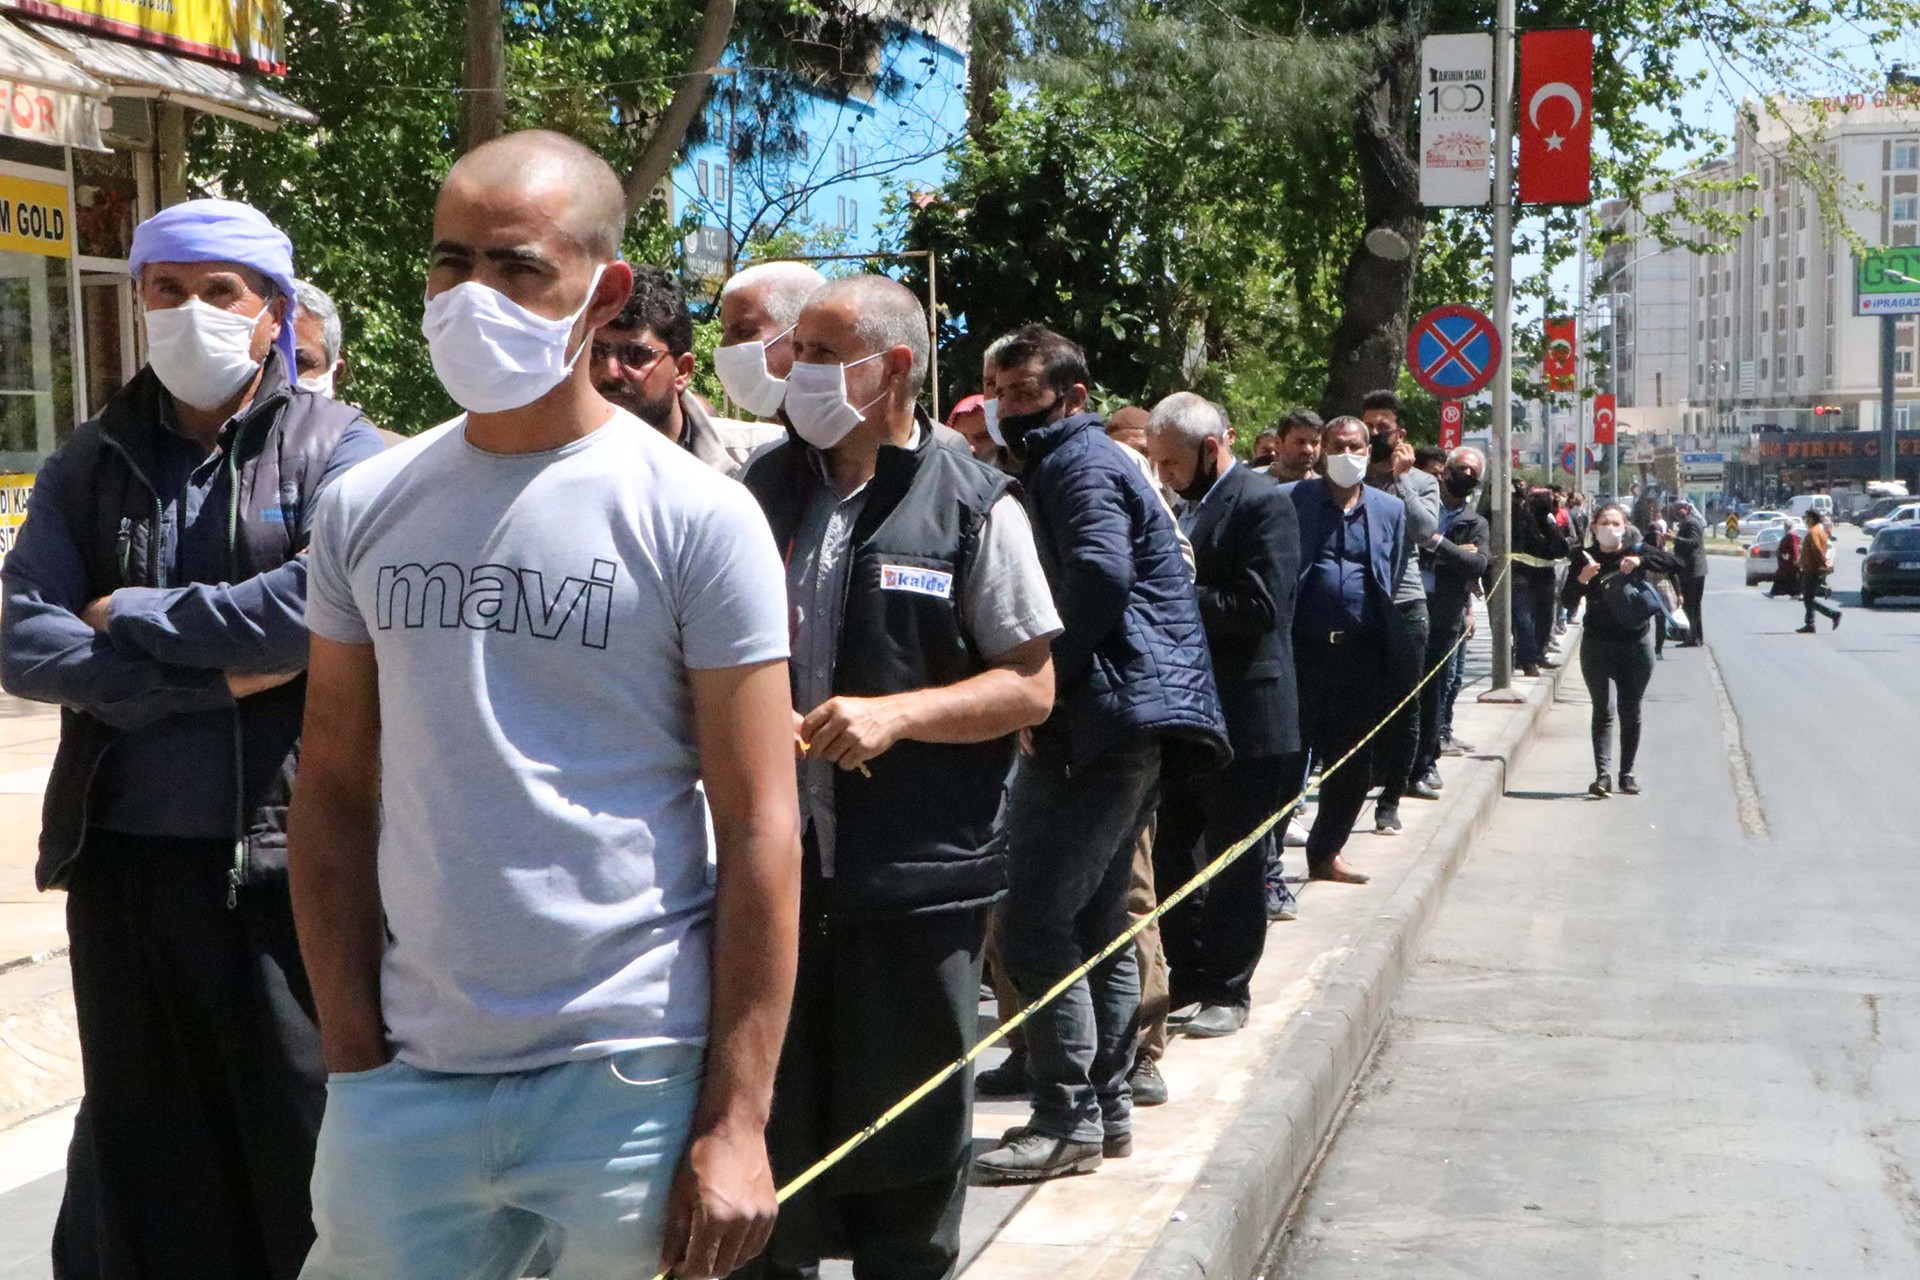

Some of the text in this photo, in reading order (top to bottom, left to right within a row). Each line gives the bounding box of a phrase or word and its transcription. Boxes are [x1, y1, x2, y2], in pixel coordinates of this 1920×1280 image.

[1815, 93, 1865, 113] RAND
[16, 202, 65, 241] GOLD
[1862, 439, 1920, 457] CFE
[376, 557, 618, 650] mavi
